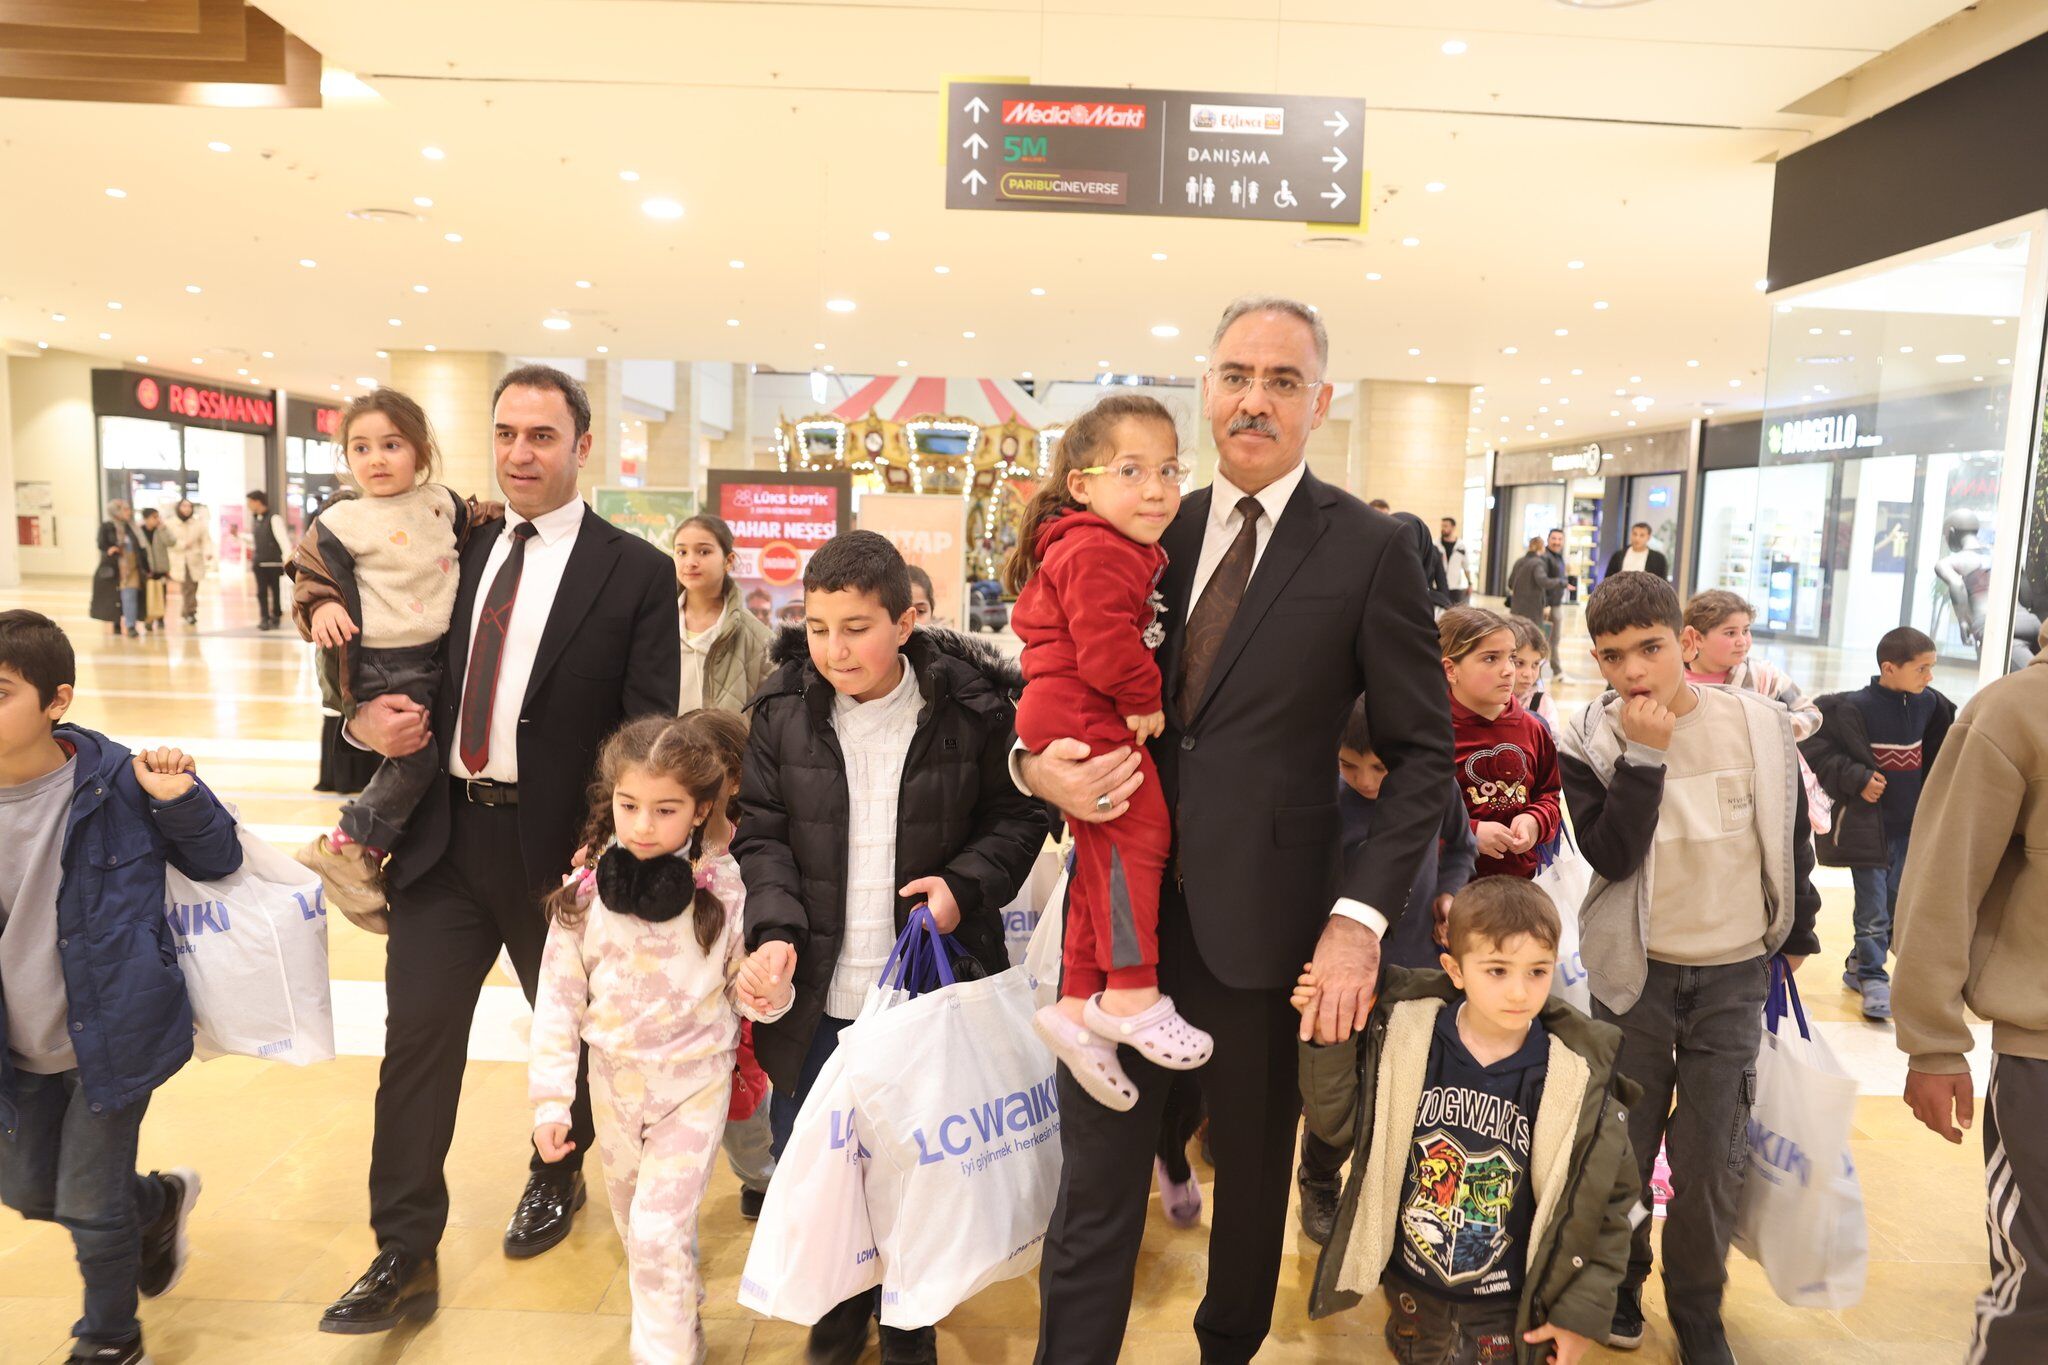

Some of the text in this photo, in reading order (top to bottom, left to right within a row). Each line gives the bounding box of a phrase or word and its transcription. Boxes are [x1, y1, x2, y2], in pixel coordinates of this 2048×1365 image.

[1003, 135, 1048, 162] 5M
[1188, 147, 1270, 167] DANIŞMA
[169, 384, 274, 427] ROSSMANN
[726, 520, 781, 538] BAHAR
[961, 1158, 974, 1178] iyi
[1014, 1126, 1053, 1152] herkesin
